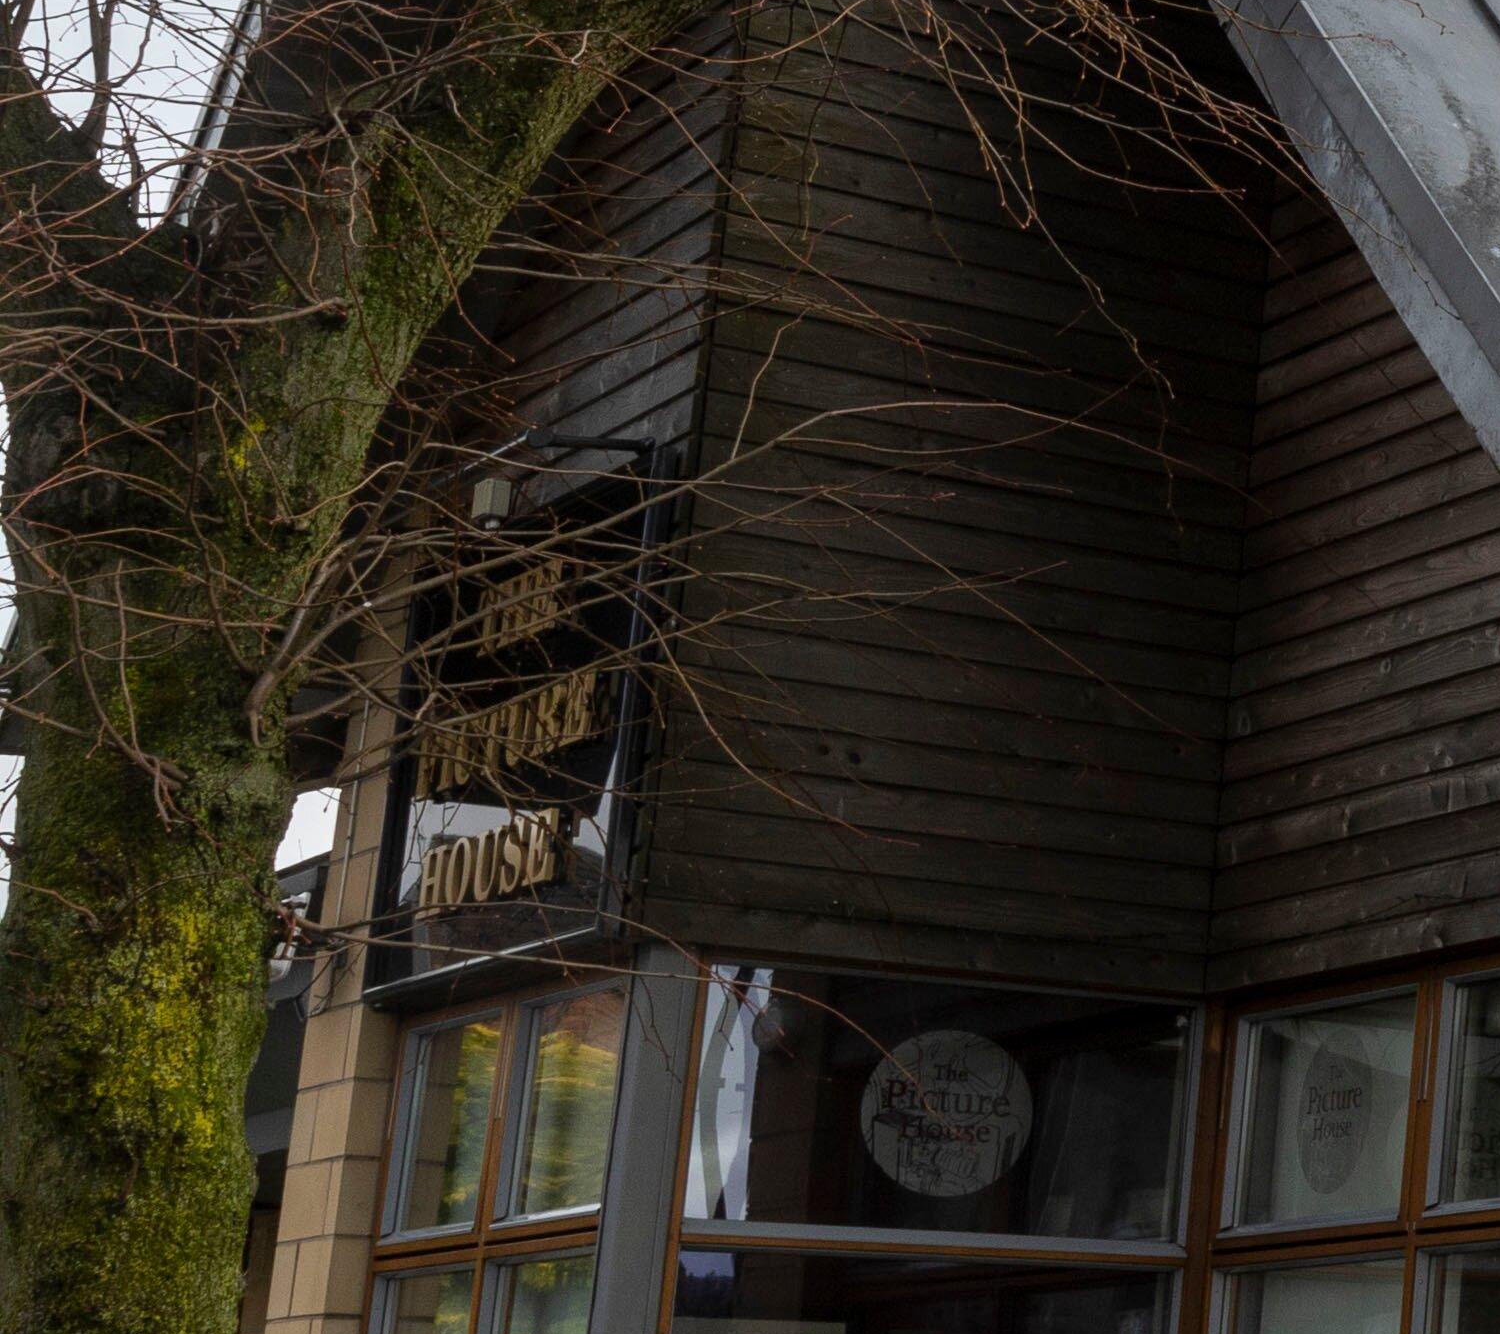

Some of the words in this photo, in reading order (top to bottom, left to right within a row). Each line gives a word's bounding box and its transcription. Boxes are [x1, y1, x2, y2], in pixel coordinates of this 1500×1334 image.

[415, 808, 561, 919] HOUSE
[934, 1063, 969, 1082] The
[883, 1078, 1011, 1118] Picture
[1306, 1085, 1363, 1115] Picture
[900, 1115, 991, 1143] House
[1312, 1117, 1353, 1142] House
